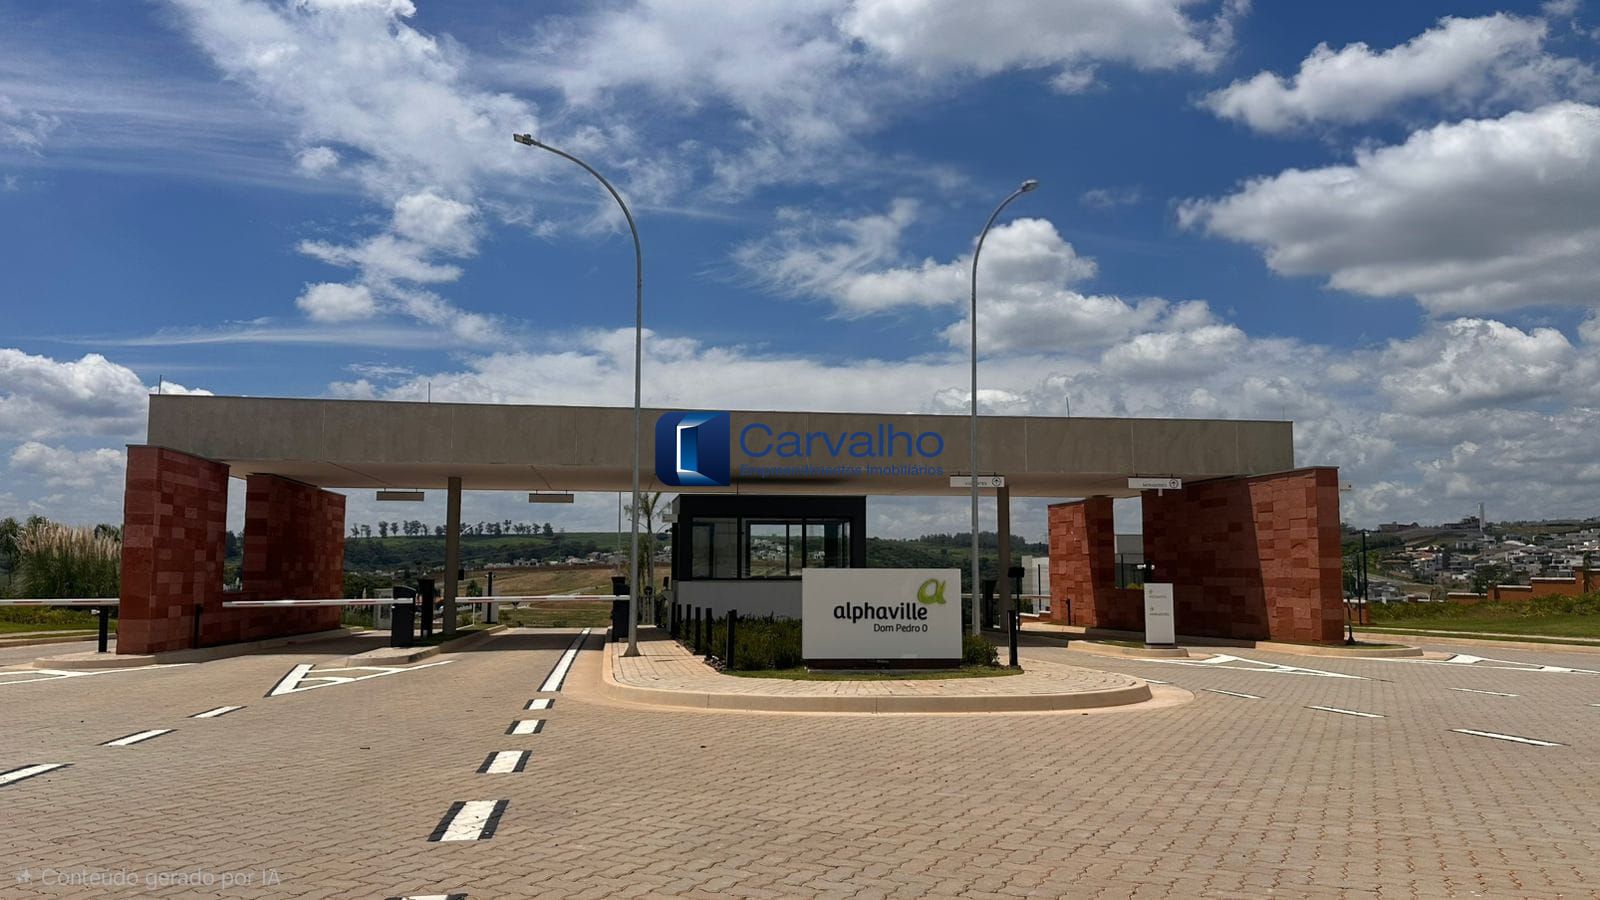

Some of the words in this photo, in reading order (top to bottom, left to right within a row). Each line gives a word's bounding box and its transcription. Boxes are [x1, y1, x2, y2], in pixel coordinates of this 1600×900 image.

[833, 602, 928, 623] alphaville
[873, 624, 894, 632] Dom
[896, 624, 920, 632] Pedro
